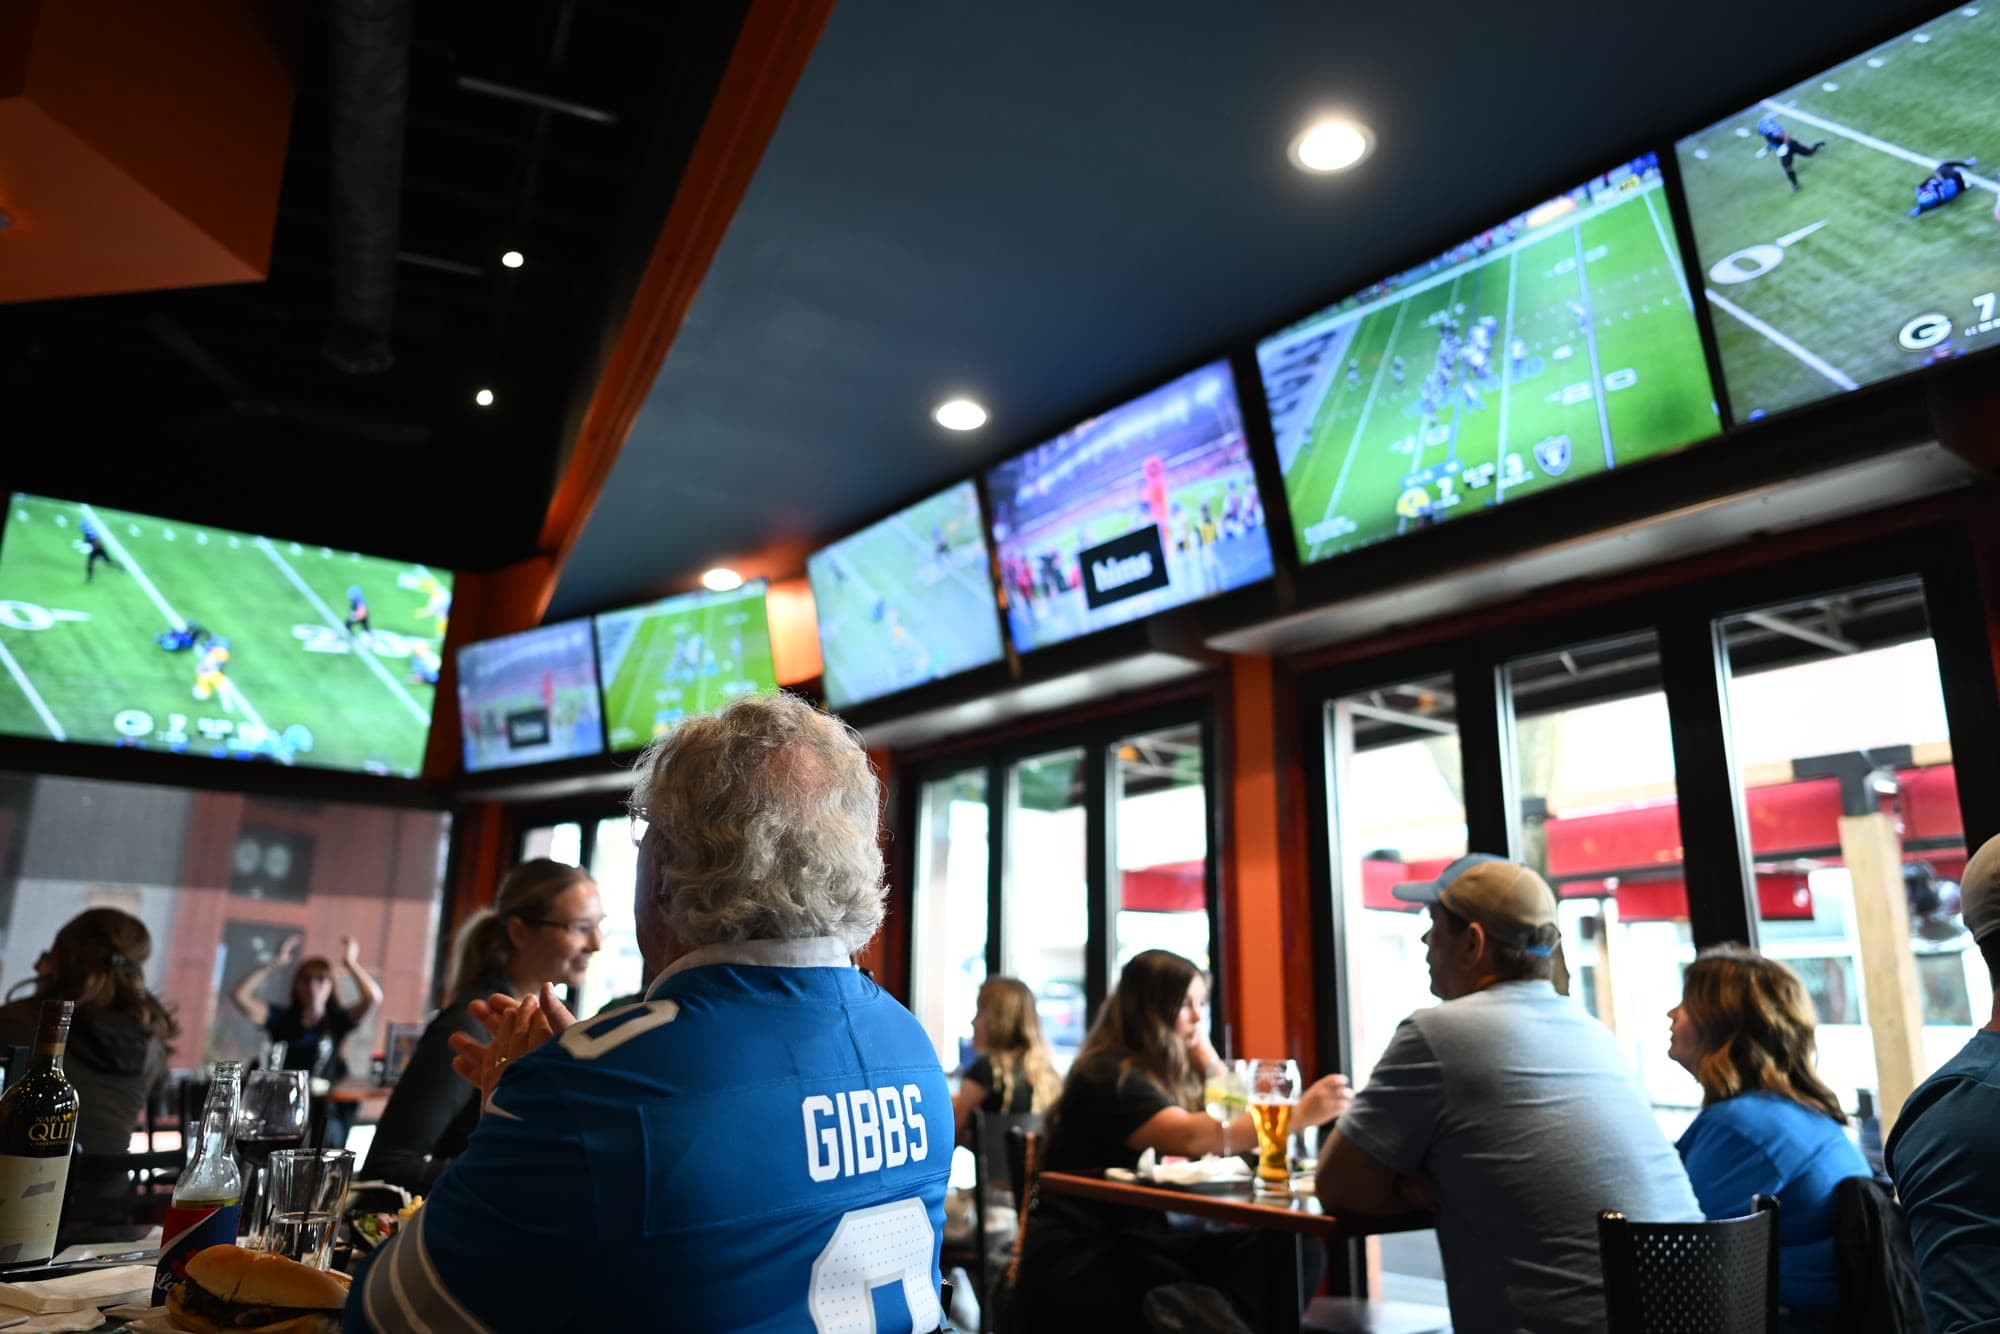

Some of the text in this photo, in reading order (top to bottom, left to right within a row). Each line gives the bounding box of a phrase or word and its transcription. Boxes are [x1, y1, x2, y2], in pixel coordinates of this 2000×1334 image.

[1898, 313, 1953, 351] G
[1972, 292, 1996, 322] 7
[802, 1083, 929, 1183] GIBBS
